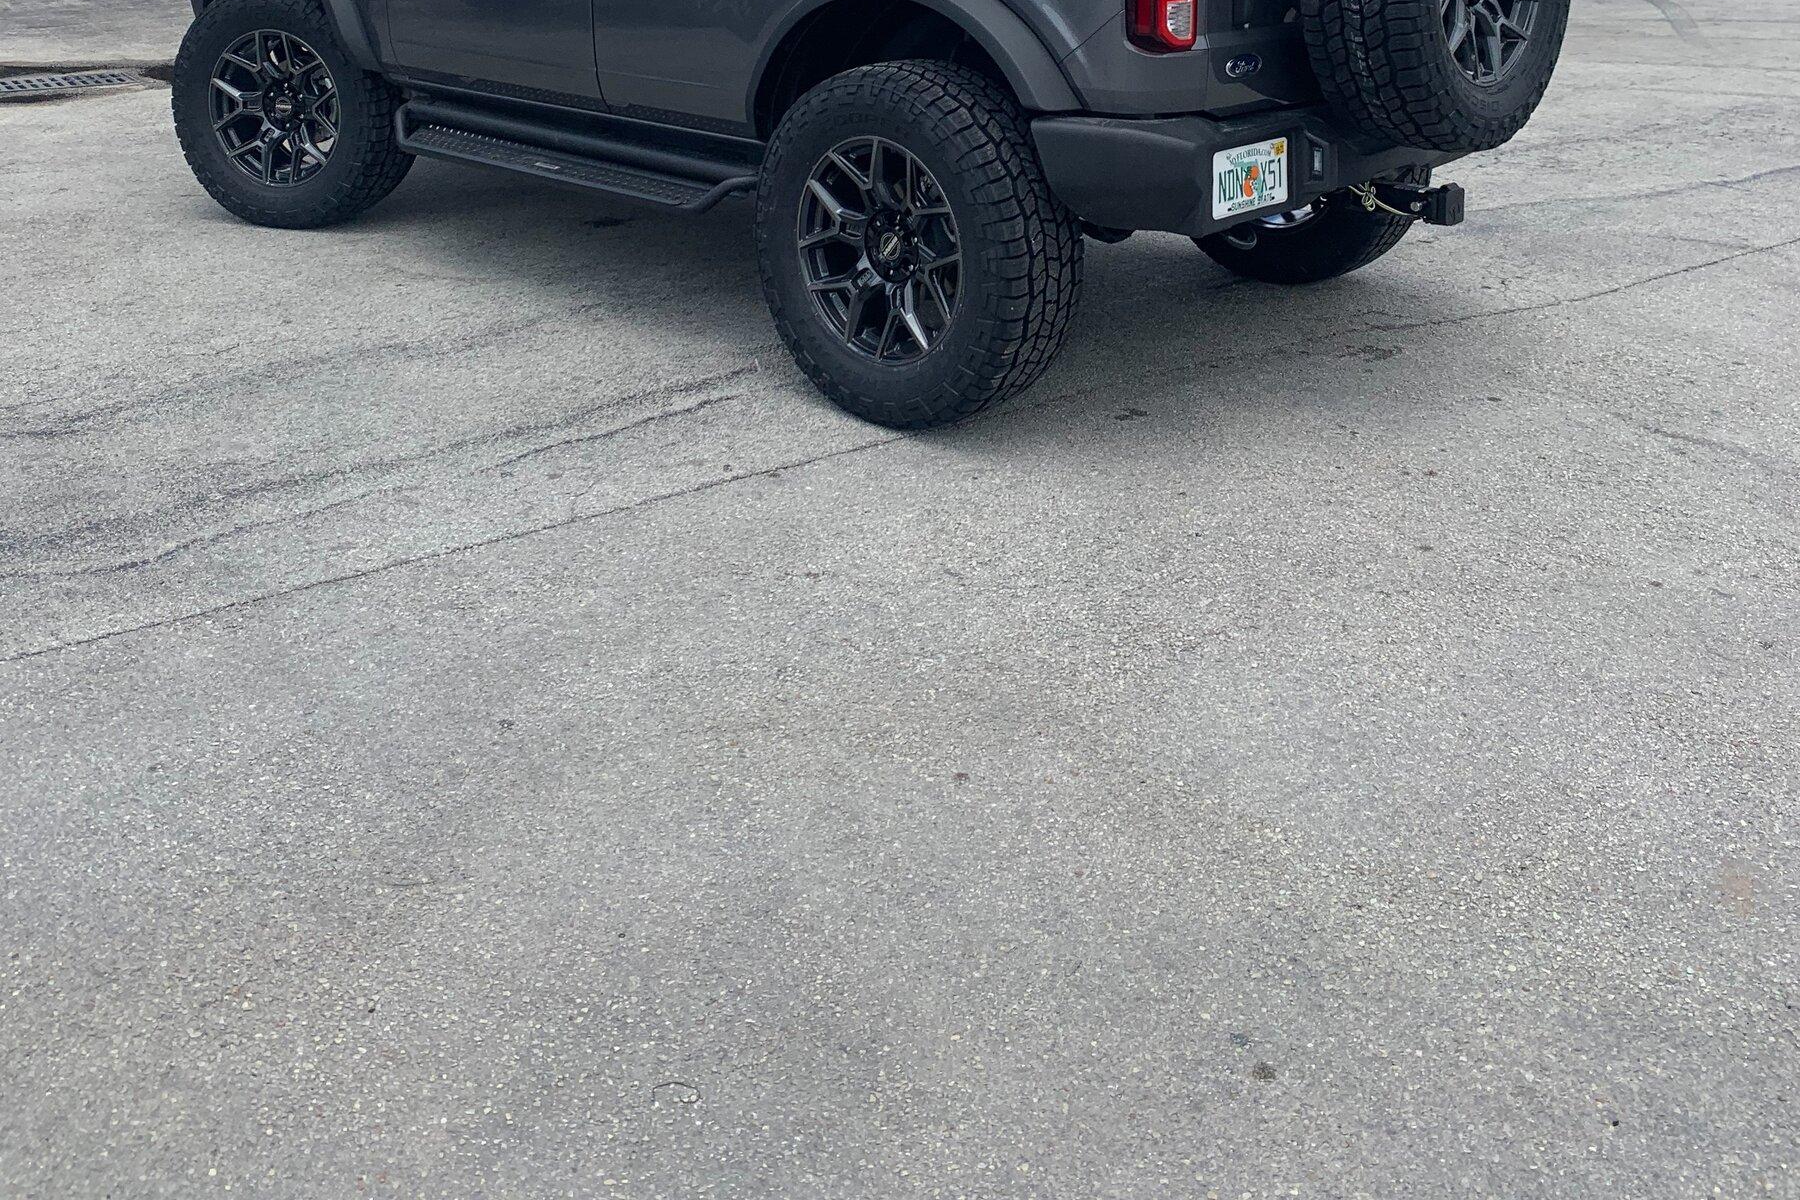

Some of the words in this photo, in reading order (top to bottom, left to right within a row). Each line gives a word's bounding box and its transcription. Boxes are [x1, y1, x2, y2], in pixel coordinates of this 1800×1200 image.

[1260, 157, 1282, 193] X51
[1231, 197, 1256, 211] SUNSHINE
[1257, 192, 1273, 205] STATE
